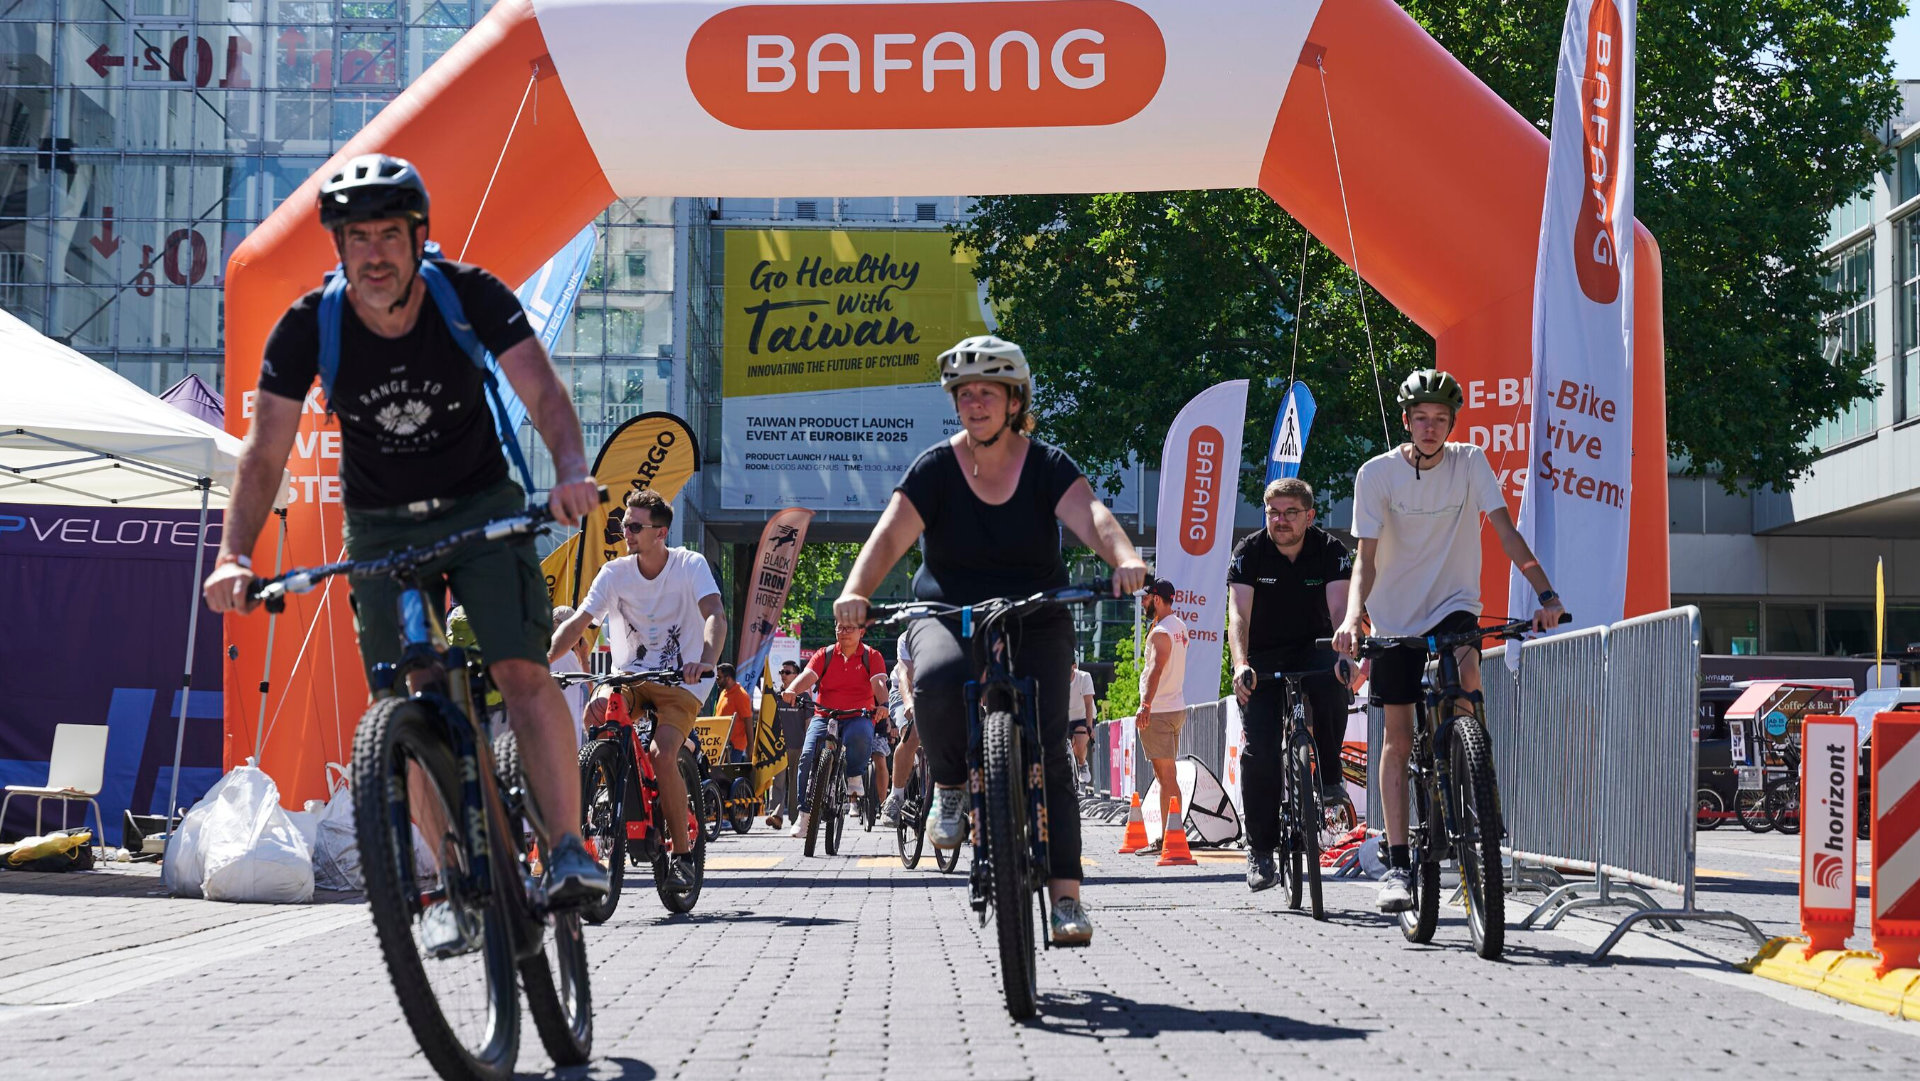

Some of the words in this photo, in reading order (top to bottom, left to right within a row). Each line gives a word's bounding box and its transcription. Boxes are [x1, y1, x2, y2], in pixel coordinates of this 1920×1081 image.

[746, 28, 1106, 94] BAFANG
[1592, 32, 1613, 267] BAFANG
[750, 260, 788, 293] Go
[796, 253, 920, 291] Healthy
[837, 287, 894, 316] With
[744, 299, 921, 355] Taiwan
[747, 362, 804, 378] INNOVATING
[807, 360, 825, 373] THE
[827, 357, 863, 372] FUTURE
[865, 356, 878, 368] OF
[879, 353, 920, 368] CYCLING
[1469, 377, 1532, 409] E-BI
[1548, 380, 1616, 423] -Bike
[746, 431, 787, 441] EVENT
[791, 431, 806, 441] AT
[809, 431, 874, 442] EUROBIKE
[876, 432, 908, 442] 2025
[747, 417, 796, 428] TAIWAN
[800, 417, 860, 428] PRODUCT
[862, 418, 914, 429] LAUNCH
[1469, 422, 1531, 453] DRI
[1547, 417, 1602, 460] rive
[745, 453, 785, 461] PRODUCT
[787, 453, 822, 461] LAUNCH
[852, 454, 863, 462] 9.1
[745, 463, 770, 471] ROOM:
[1189, 441, 1214, 541] BAFANG
[763, 552, 791, 570] BLACK
[759, 571, 787, 591] IRON
[755, 593, 781, 609] HORSE
[1175, 589, 1207, 606] Bike
[1817, 700, 1834, 710] Bar
[700, 737, 722, 746] ACK,
[1822, 743, 1845, 852] horizont
